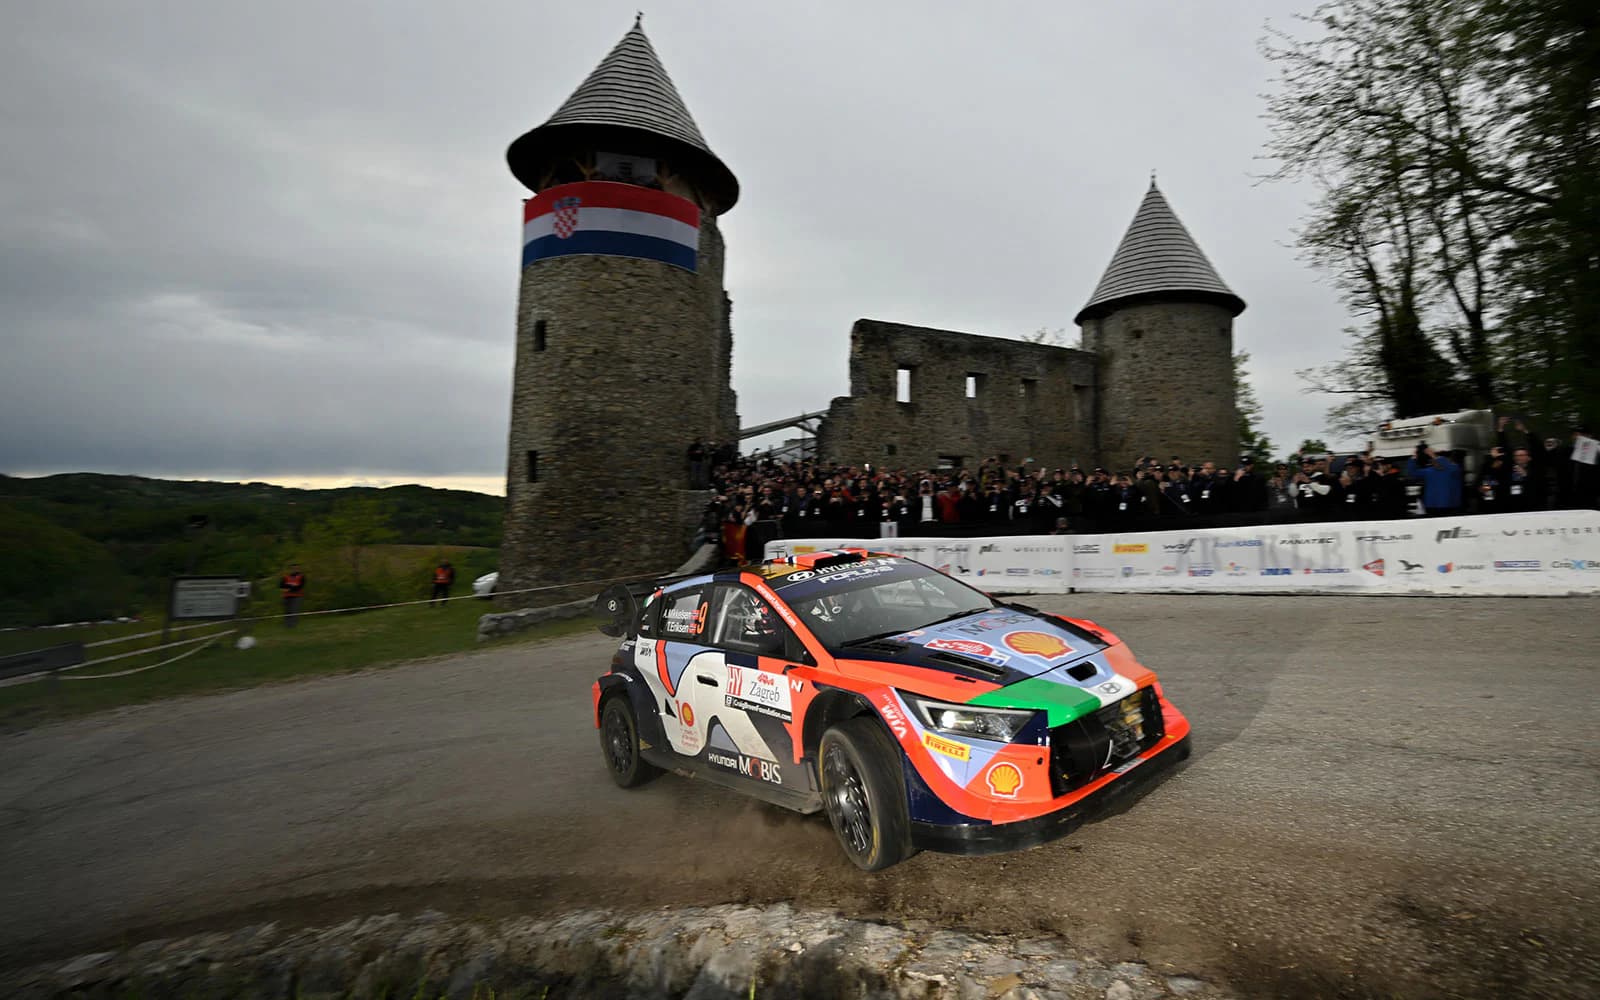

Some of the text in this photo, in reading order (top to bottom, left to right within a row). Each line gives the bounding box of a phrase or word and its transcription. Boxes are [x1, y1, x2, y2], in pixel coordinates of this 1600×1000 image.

[1280, 537, 1336, 545] FANATEC
[697, 601, 708, 634] 9
[749, 681, 781, 703] Zagreb
[925, 735, 966, 758] PIRELLI
[708, 753, 782, 785] HYUNDAI MOBIS
